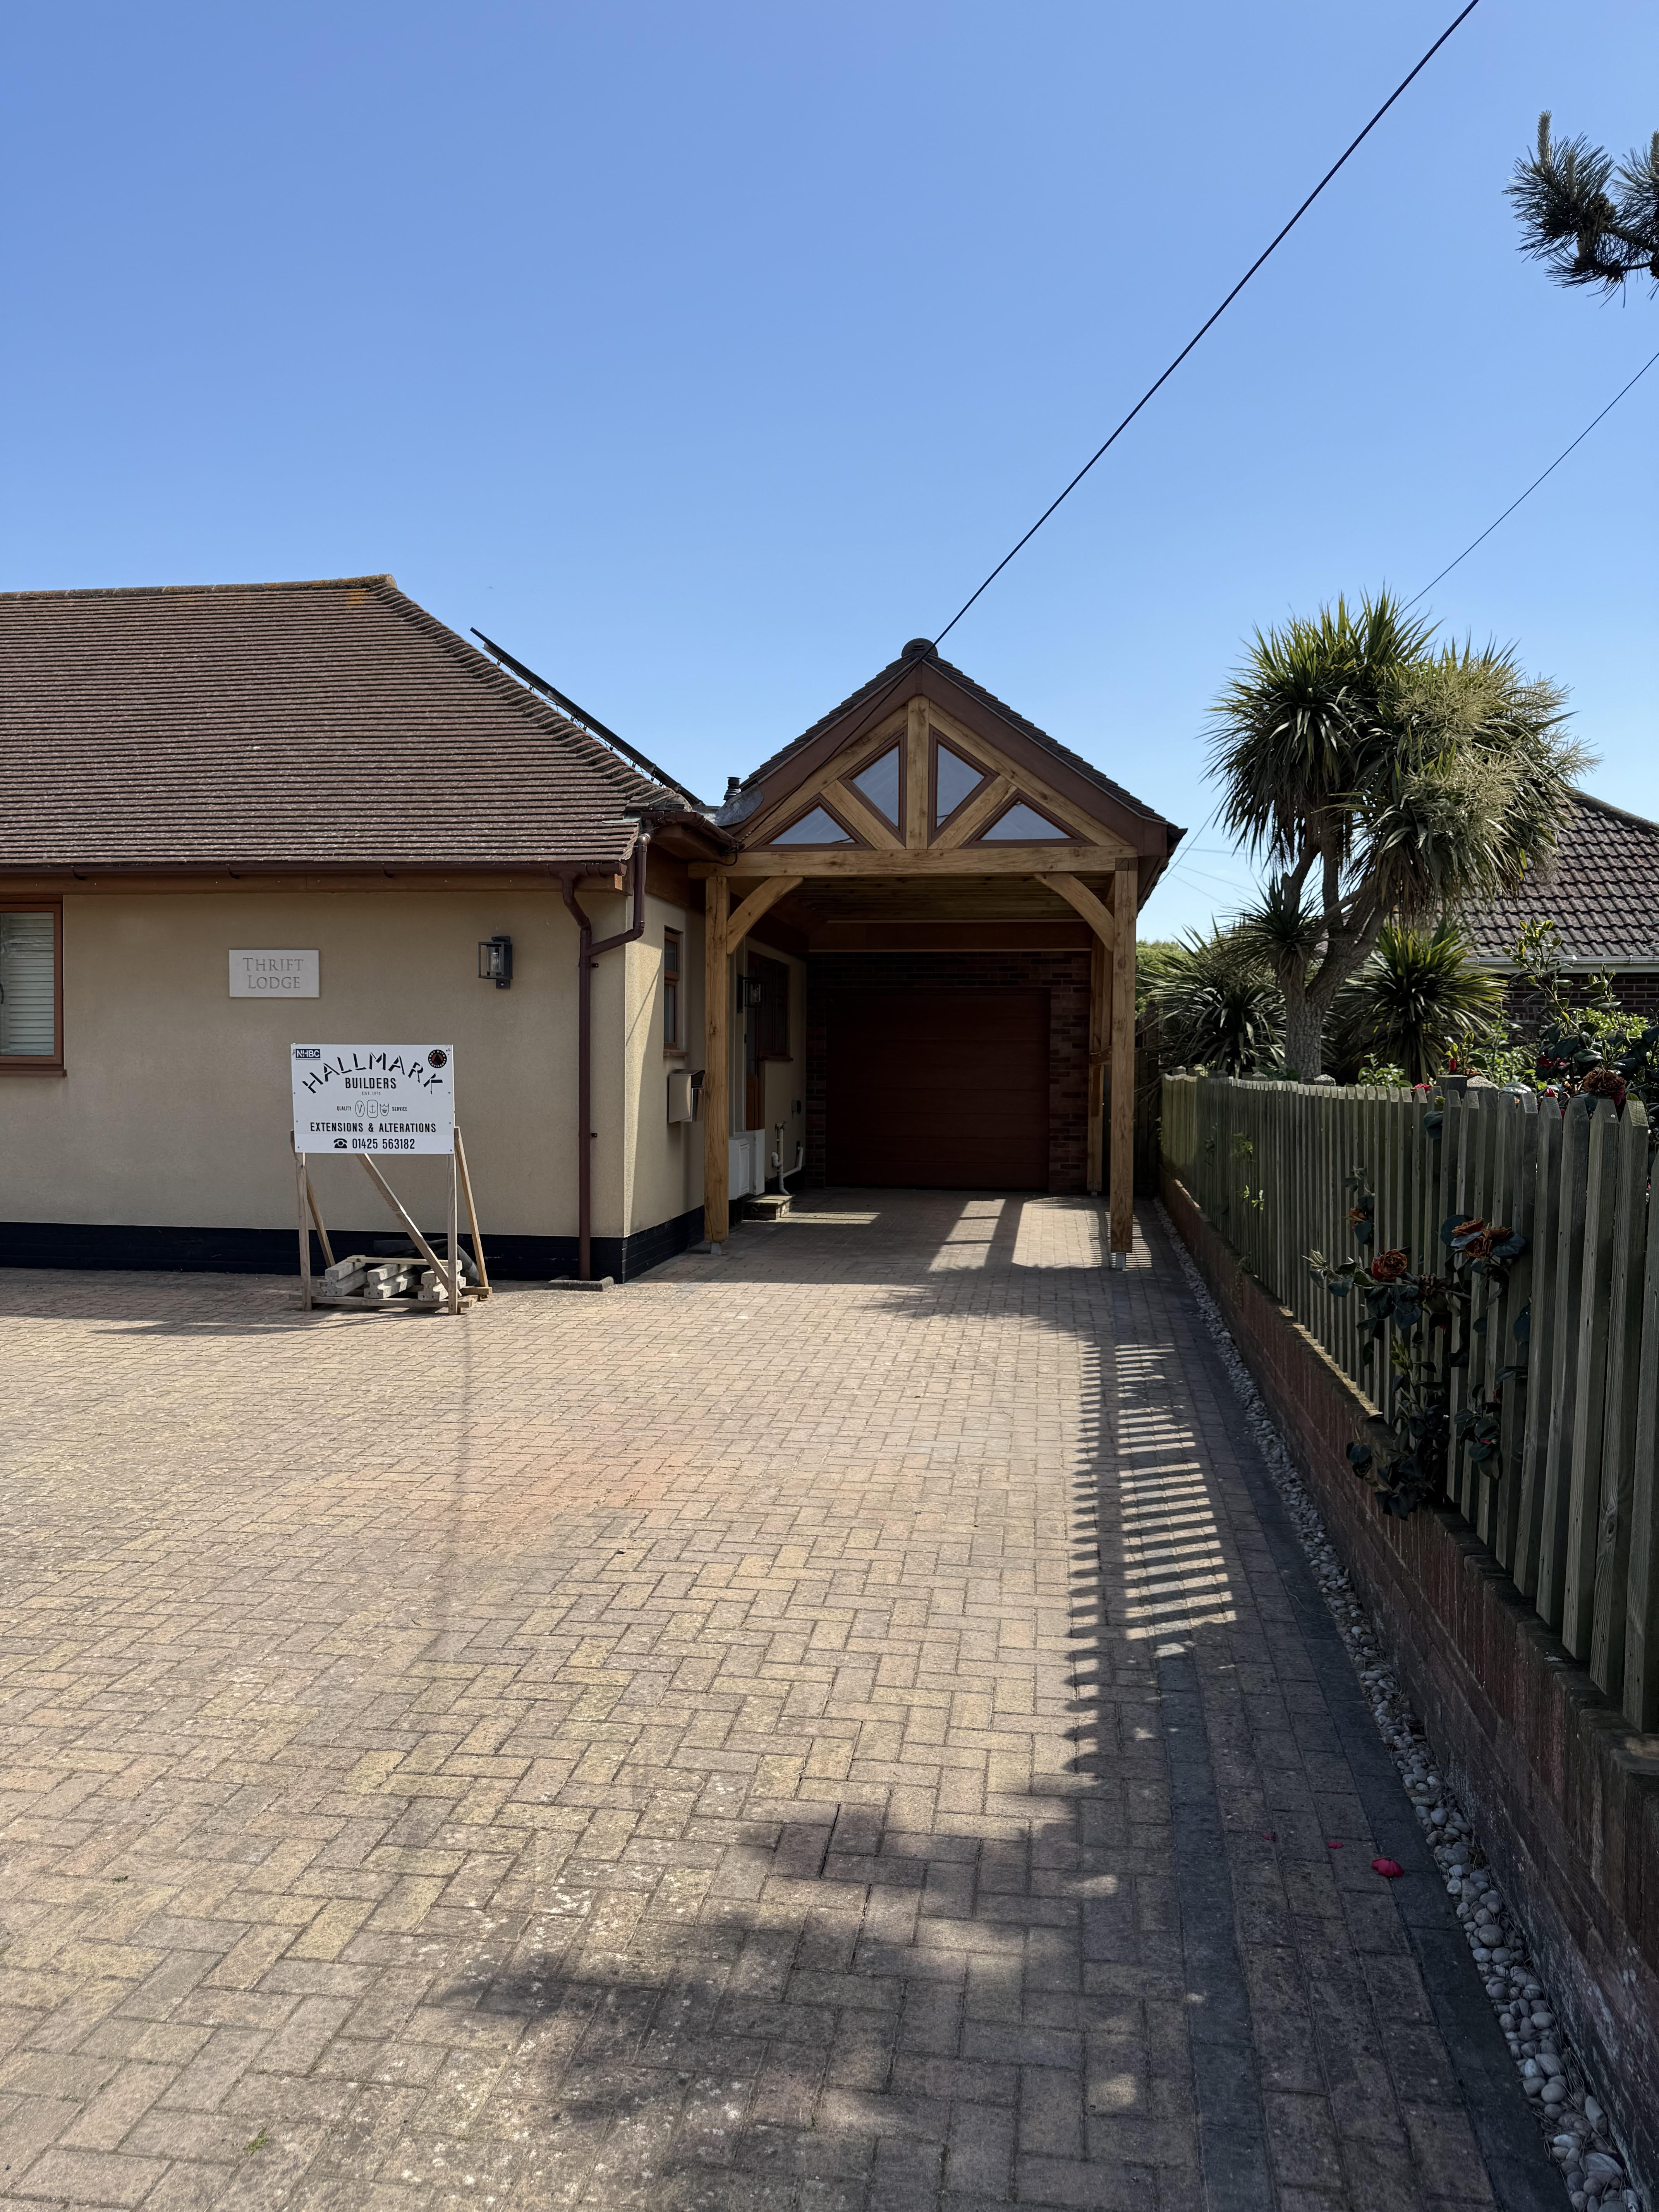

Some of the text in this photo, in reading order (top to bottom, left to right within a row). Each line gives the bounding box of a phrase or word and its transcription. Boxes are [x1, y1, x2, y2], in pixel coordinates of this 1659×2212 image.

[243, 957, 304, 971] THRIFT
[248, 975, 301, 989] LODGE
[302, 1051, 443, 1094] HALLMARK
[345, 1077, 397, 1089] BUILDERS
[310, 1122, 436, 1133] EXTENSIONS & ALTERATIONS
[352, 1139, 416, 1149] 01425 563182
